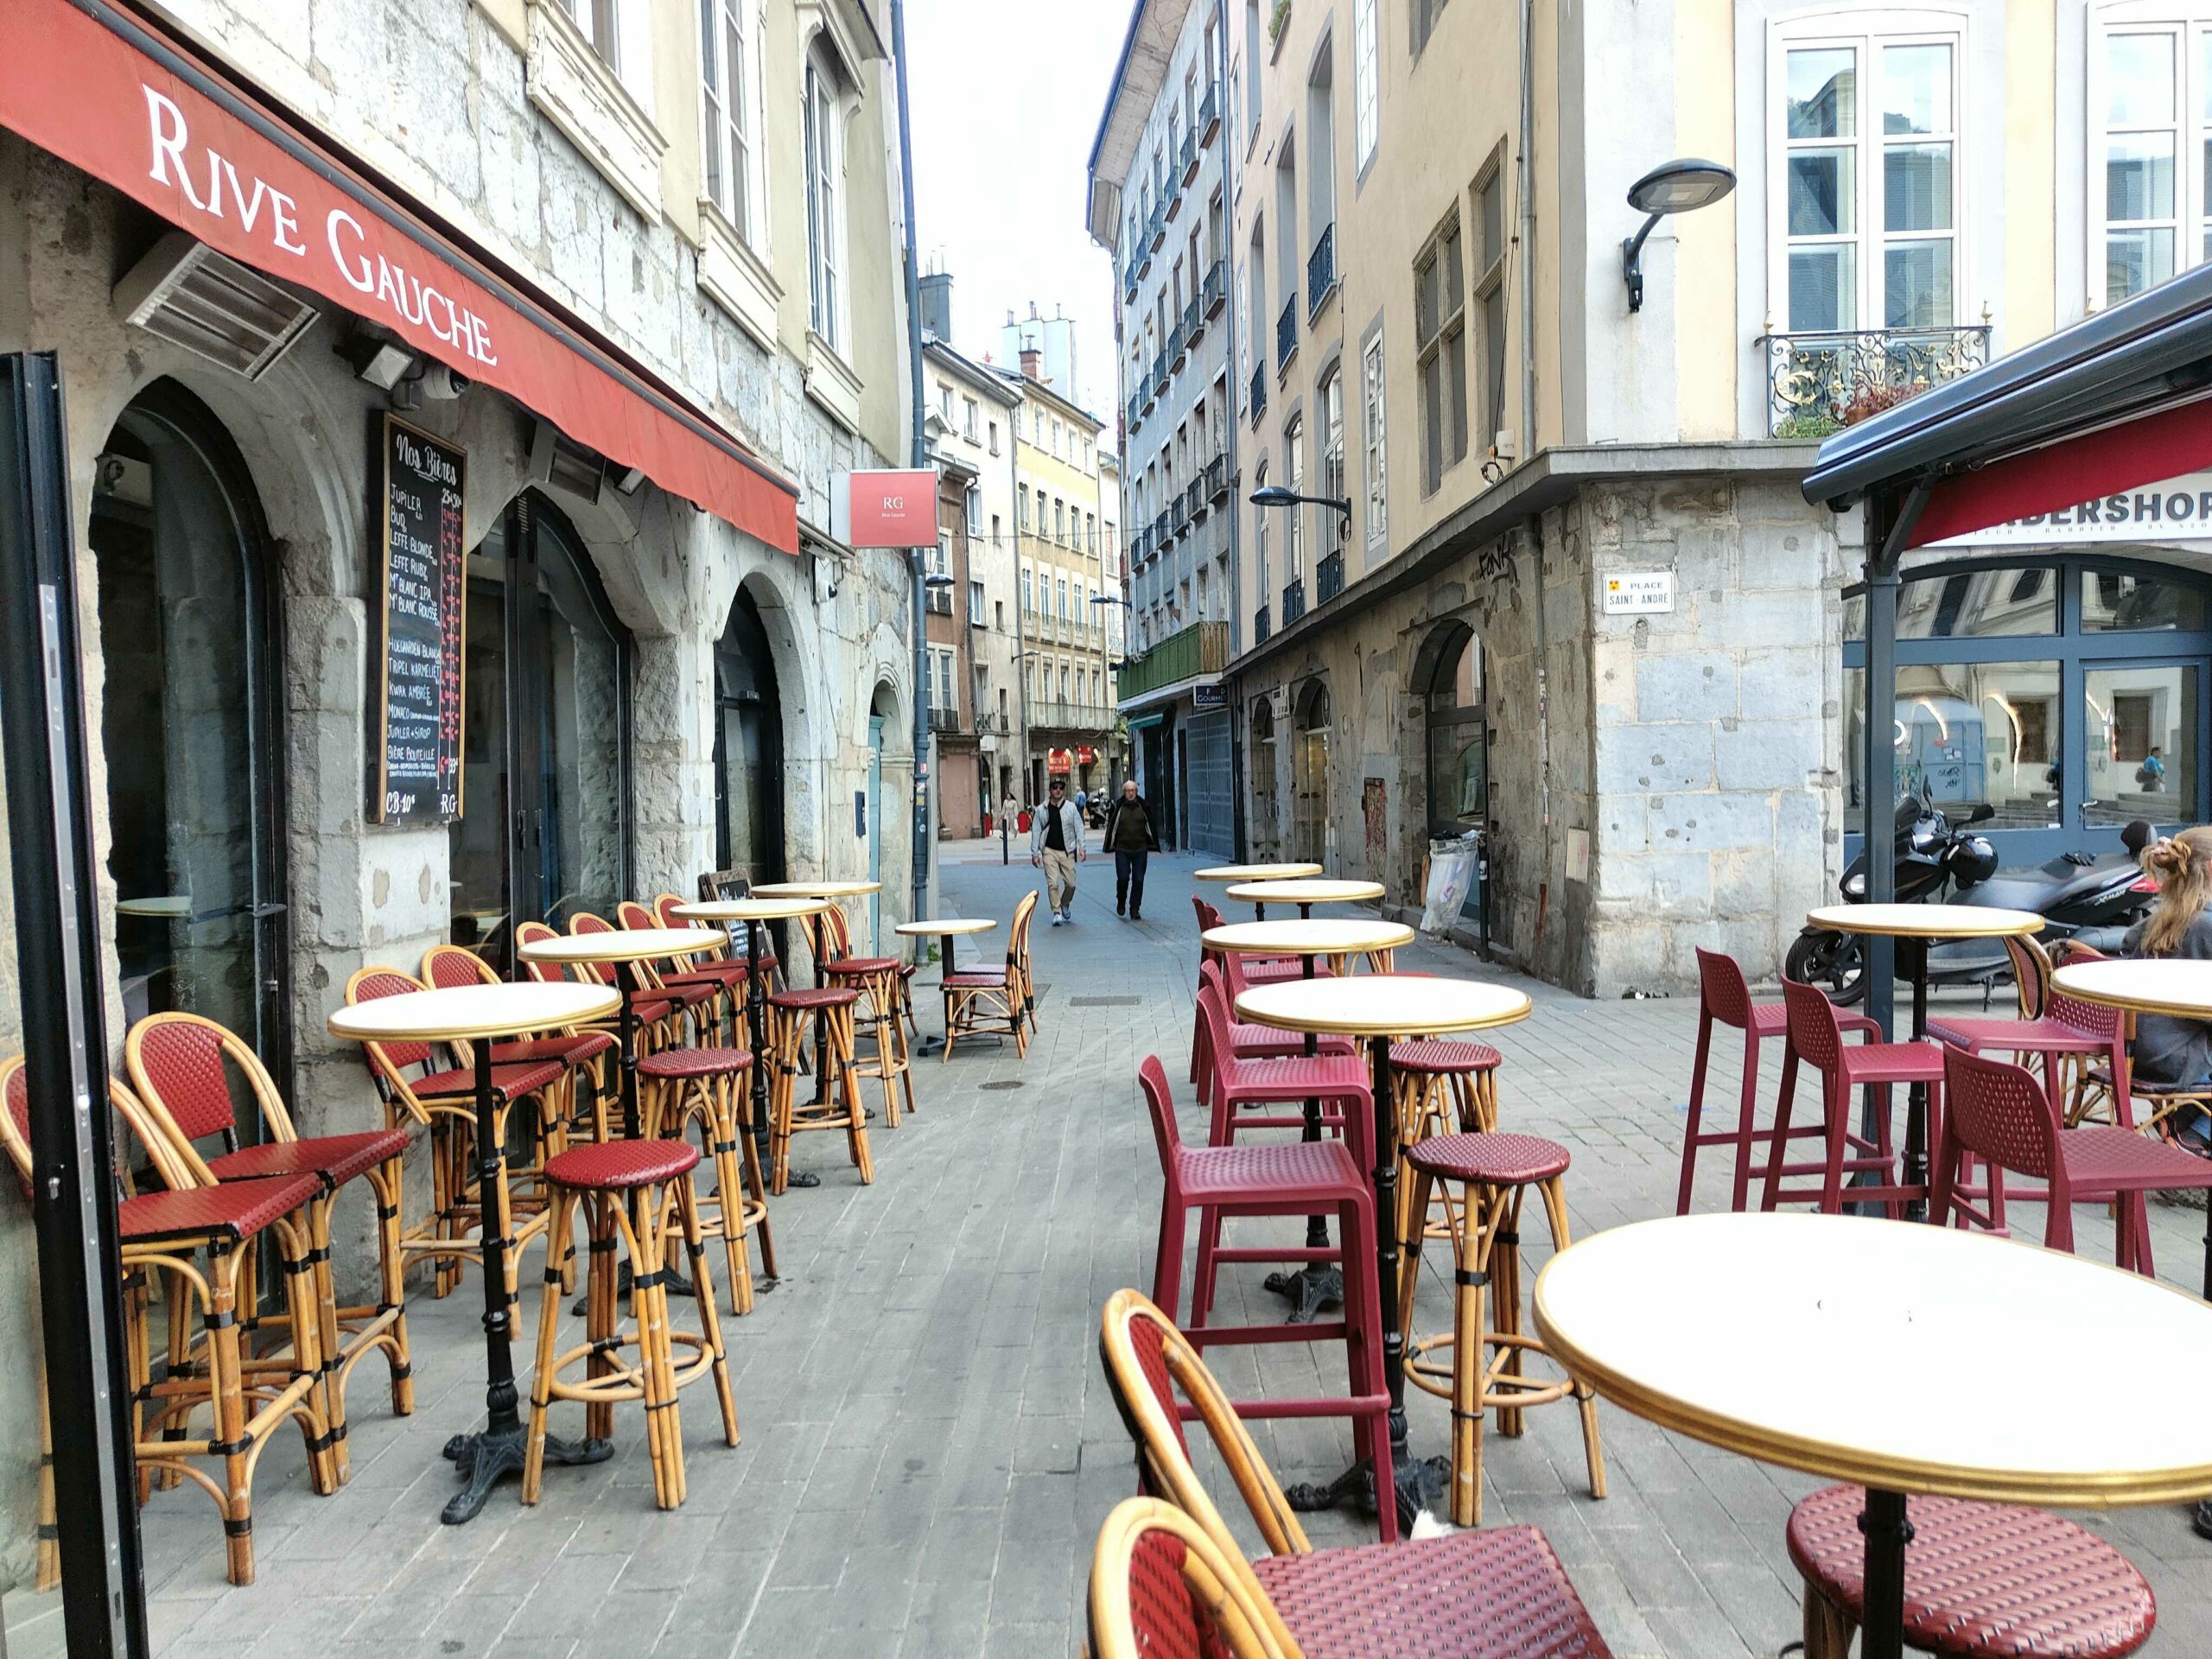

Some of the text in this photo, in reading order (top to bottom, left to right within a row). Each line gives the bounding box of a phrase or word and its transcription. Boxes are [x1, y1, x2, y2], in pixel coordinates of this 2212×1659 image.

[143, 84, 497, 366] RIVE GAUCHE
[397, 434, 456, 486] Nos Bières
[883, 496, 904, 510] RG
[391, 504, 405, 528] BUD
[390, 528, 433, 559] LEFFE BLONDE
[390, 549, 409, 573] LEFFE
[398, 577, 417, 599] BLANC
[419, 585, 433, 602] IPA
[398, 595, 416, 615] BLANC
[418, 601, 438, 621] ROUSSE
[388, 658, 409, 676] TRIPEL
[389, 680, 407, 698] KWAK
[1197, 694, 1227, 702] GOURM
[388, 703, 410, 720] MONACO
[387, 745, 404, 760] BIÈRE
[406, 747, 435, 761] BOUTEILLE
